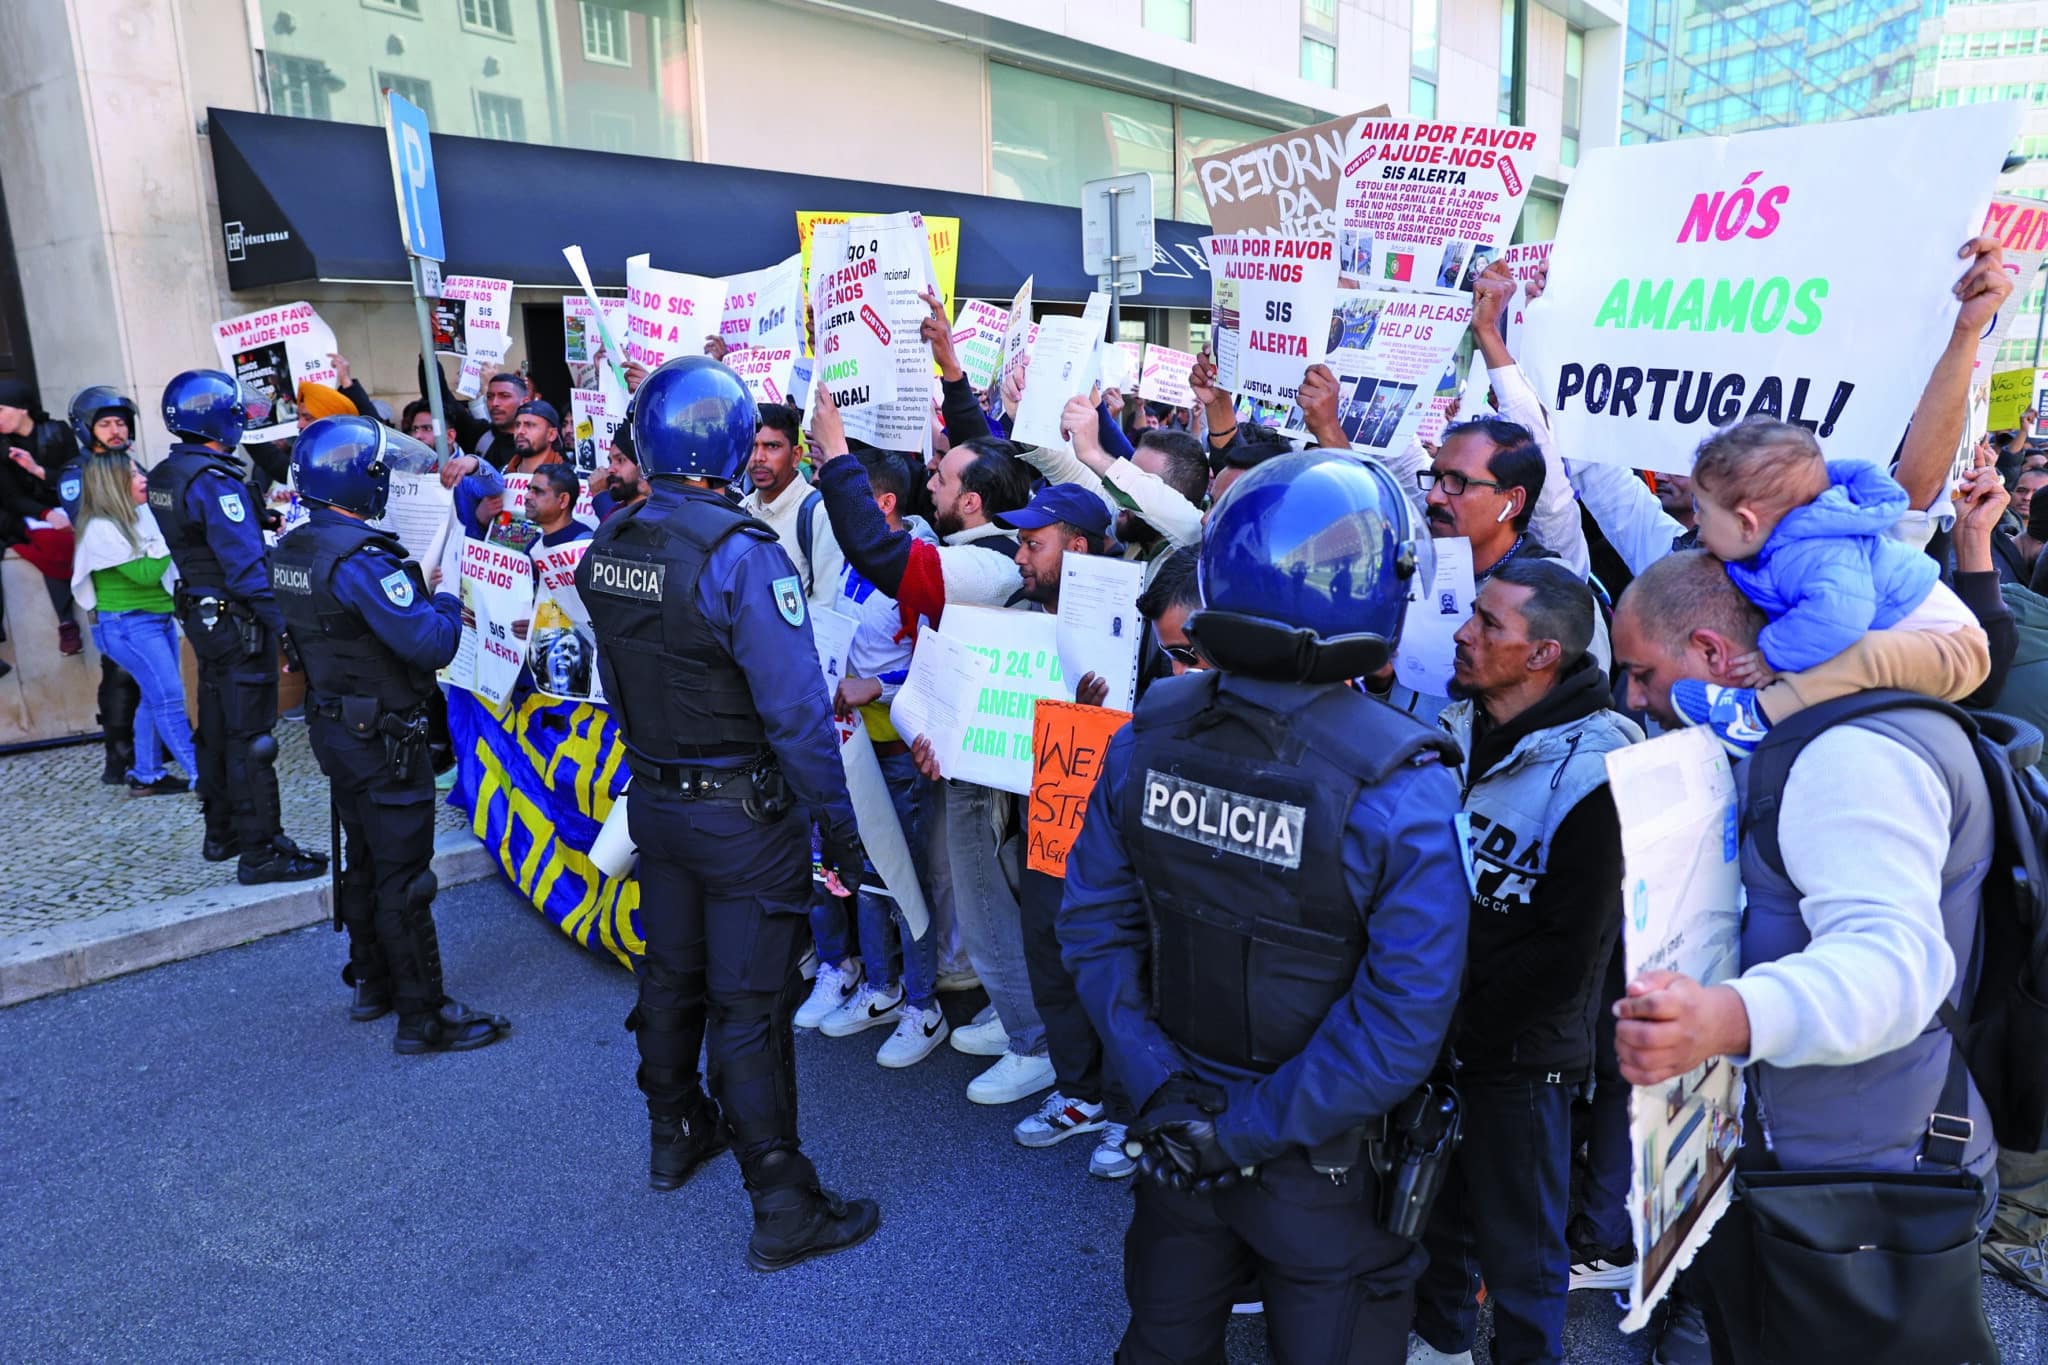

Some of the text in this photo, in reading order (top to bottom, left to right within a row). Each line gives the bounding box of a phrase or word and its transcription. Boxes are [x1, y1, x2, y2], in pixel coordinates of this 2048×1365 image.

[1361, 122, 1537, 151] AIMA POR FAVOR
[1378, 143, 1498, 169] AJUDE-NOS
[1382, 166, 1466, 185] SIS ALERTA
[1356, 180, 1499, 202] ESTOU EM PORTUGAL 3 ANOS
[1361, 191, 1367, 200] A
[1369, 191, 1398, 202] MINHA
[1439, 197, 1446, 206] E
[1447, 197, 1485, 211] FILHOS
[1276, 186, 1322, 221] DA
[1371, 201, 1384, 210] NO
[1385, 202, 1427, 214] HOSPITAL
[1429, 206, 1445, 216] EM
[1676, 170, 1791, 244] NÓS
[1354, 209, 1367, 219] SIS
[1416, 215, 1458, 228] PRECISO
[1459, 220, 1482, 231] DOS
[1344, 218, 1495, 244] DOCUMENTOS ASSIM COMO TODOS
[1374, 230, 1444, 247] OS EMIGRANTES
[1211, 239, 1239, 256] AIMA
[1242, 239, 1270, 257] POR
[1275, 240, 1332, 260] FAVOR
[1522, 243, 1554, 261] FAV
[837, 258, 877, 286] FAVOR
[1225, 262, 1304, 283] AJUDE-NOS
[444, 289, 493, 302] AJUDE-NOS
[458, 279, 507, 292] POR FAVOR
[478, 306, 493, 317] SIS
[566, 298, 584, 307] AIMA
[643, 291, 661, 311] DO
[667, 297, 696, 317] SIS:
[732, 294, 745, 309] DO
[968, 302, 997, 318] AIMA
[1265, 300, 1293, 323] SIS
[1593, 276, 1830, 336] AMAMOS
[1384, 302, 1473, 323] AIMA PLEASE
[219, 319, 253, 338] AIMA
[254, 312, 279, 329] POR
[239, 322, 310, 348] AJUDE-NOS
[469, 319, 501, 330] ALERTA
[667, 326, 680, 343] A
[861, 307, 891, 345] JUSTIÇA
[1378, 321, 1434, 341] HELP US
[979, 331, 995, 342] SIS
[1249, 330, 1308, 358] ALERTA
[304, 359, 321, 371] SIS
[732, 350, 791, 367] POR FAVOR
[970, 371, 989, 386] PARA
[1243, 379, 1273, 396] JUSTIÇA
[574, 391, 606, 404] AIMA POR
[1554, 362, 1856, 439] PORTUGAL!
[406, 483, 419, 496] 77
[467, 545, 531, 577] POR FAVOR
[273, 567, 310, 590] POLICIA
[592, 562, 660, 595] POLICIA
[489, 621, 506, 640] SIS
[484, 638, 520, 666] ALERTA
[962, 726, 1008, 758] PARA
[1147, 781, 1295, 856] POLICIA
